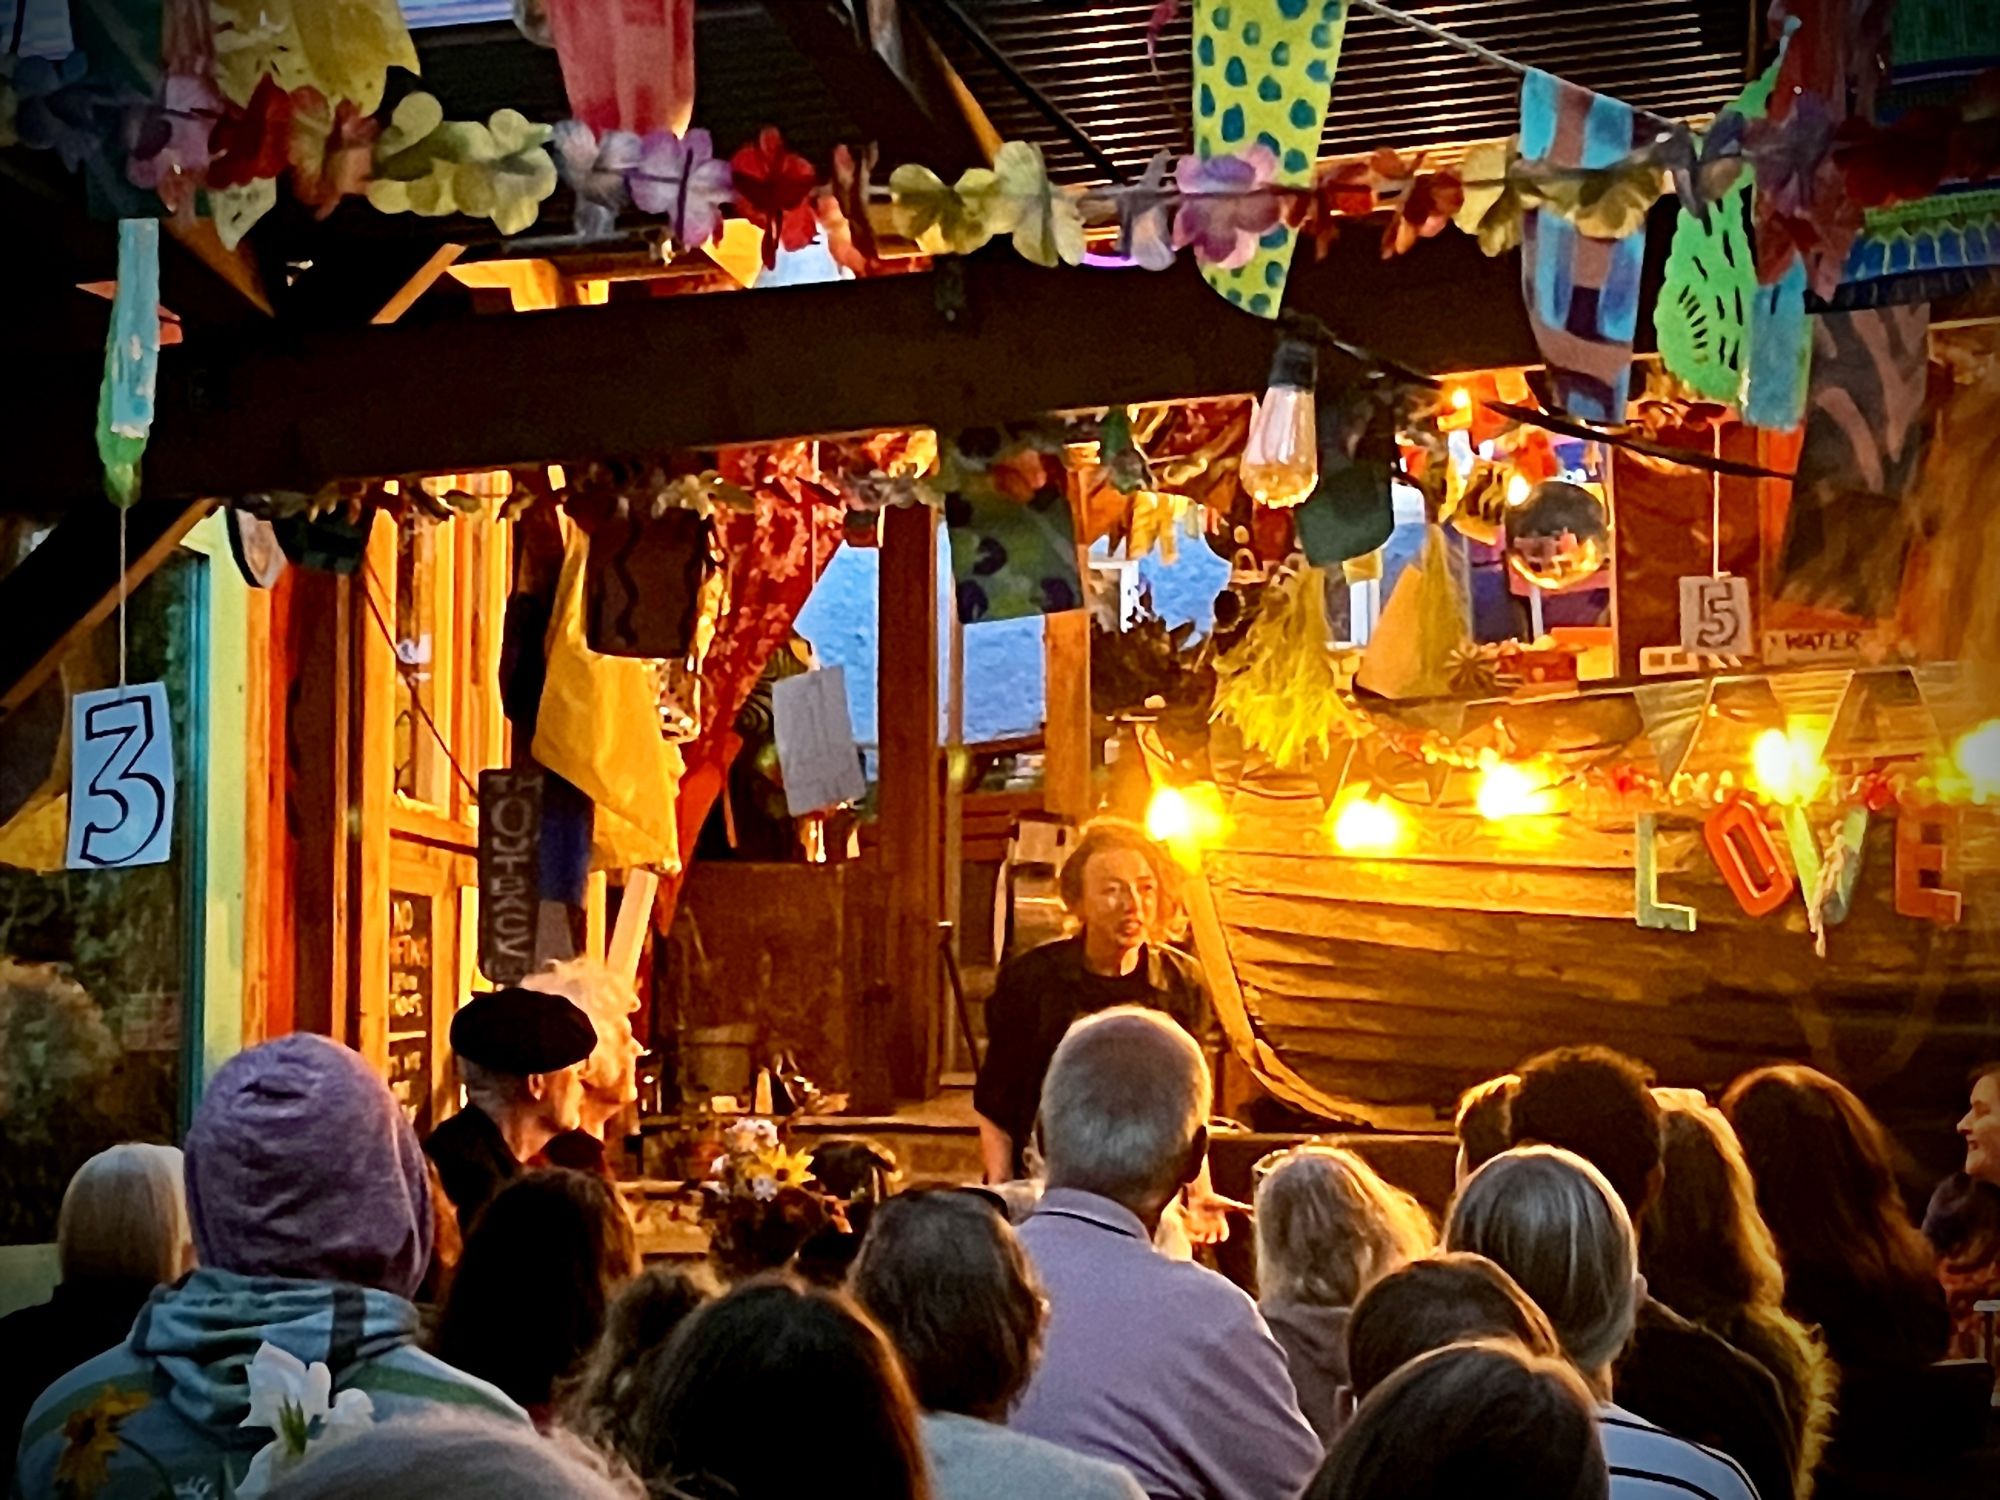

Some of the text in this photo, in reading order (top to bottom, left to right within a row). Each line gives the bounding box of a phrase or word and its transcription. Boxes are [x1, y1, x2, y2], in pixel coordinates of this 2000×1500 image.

[1697, 582, 1740, 647] 5
[1785, 631, 1862, 651] WATER
[80, 695, 165, 865] 3
[1635, 795, 1961, 933] LOVE
